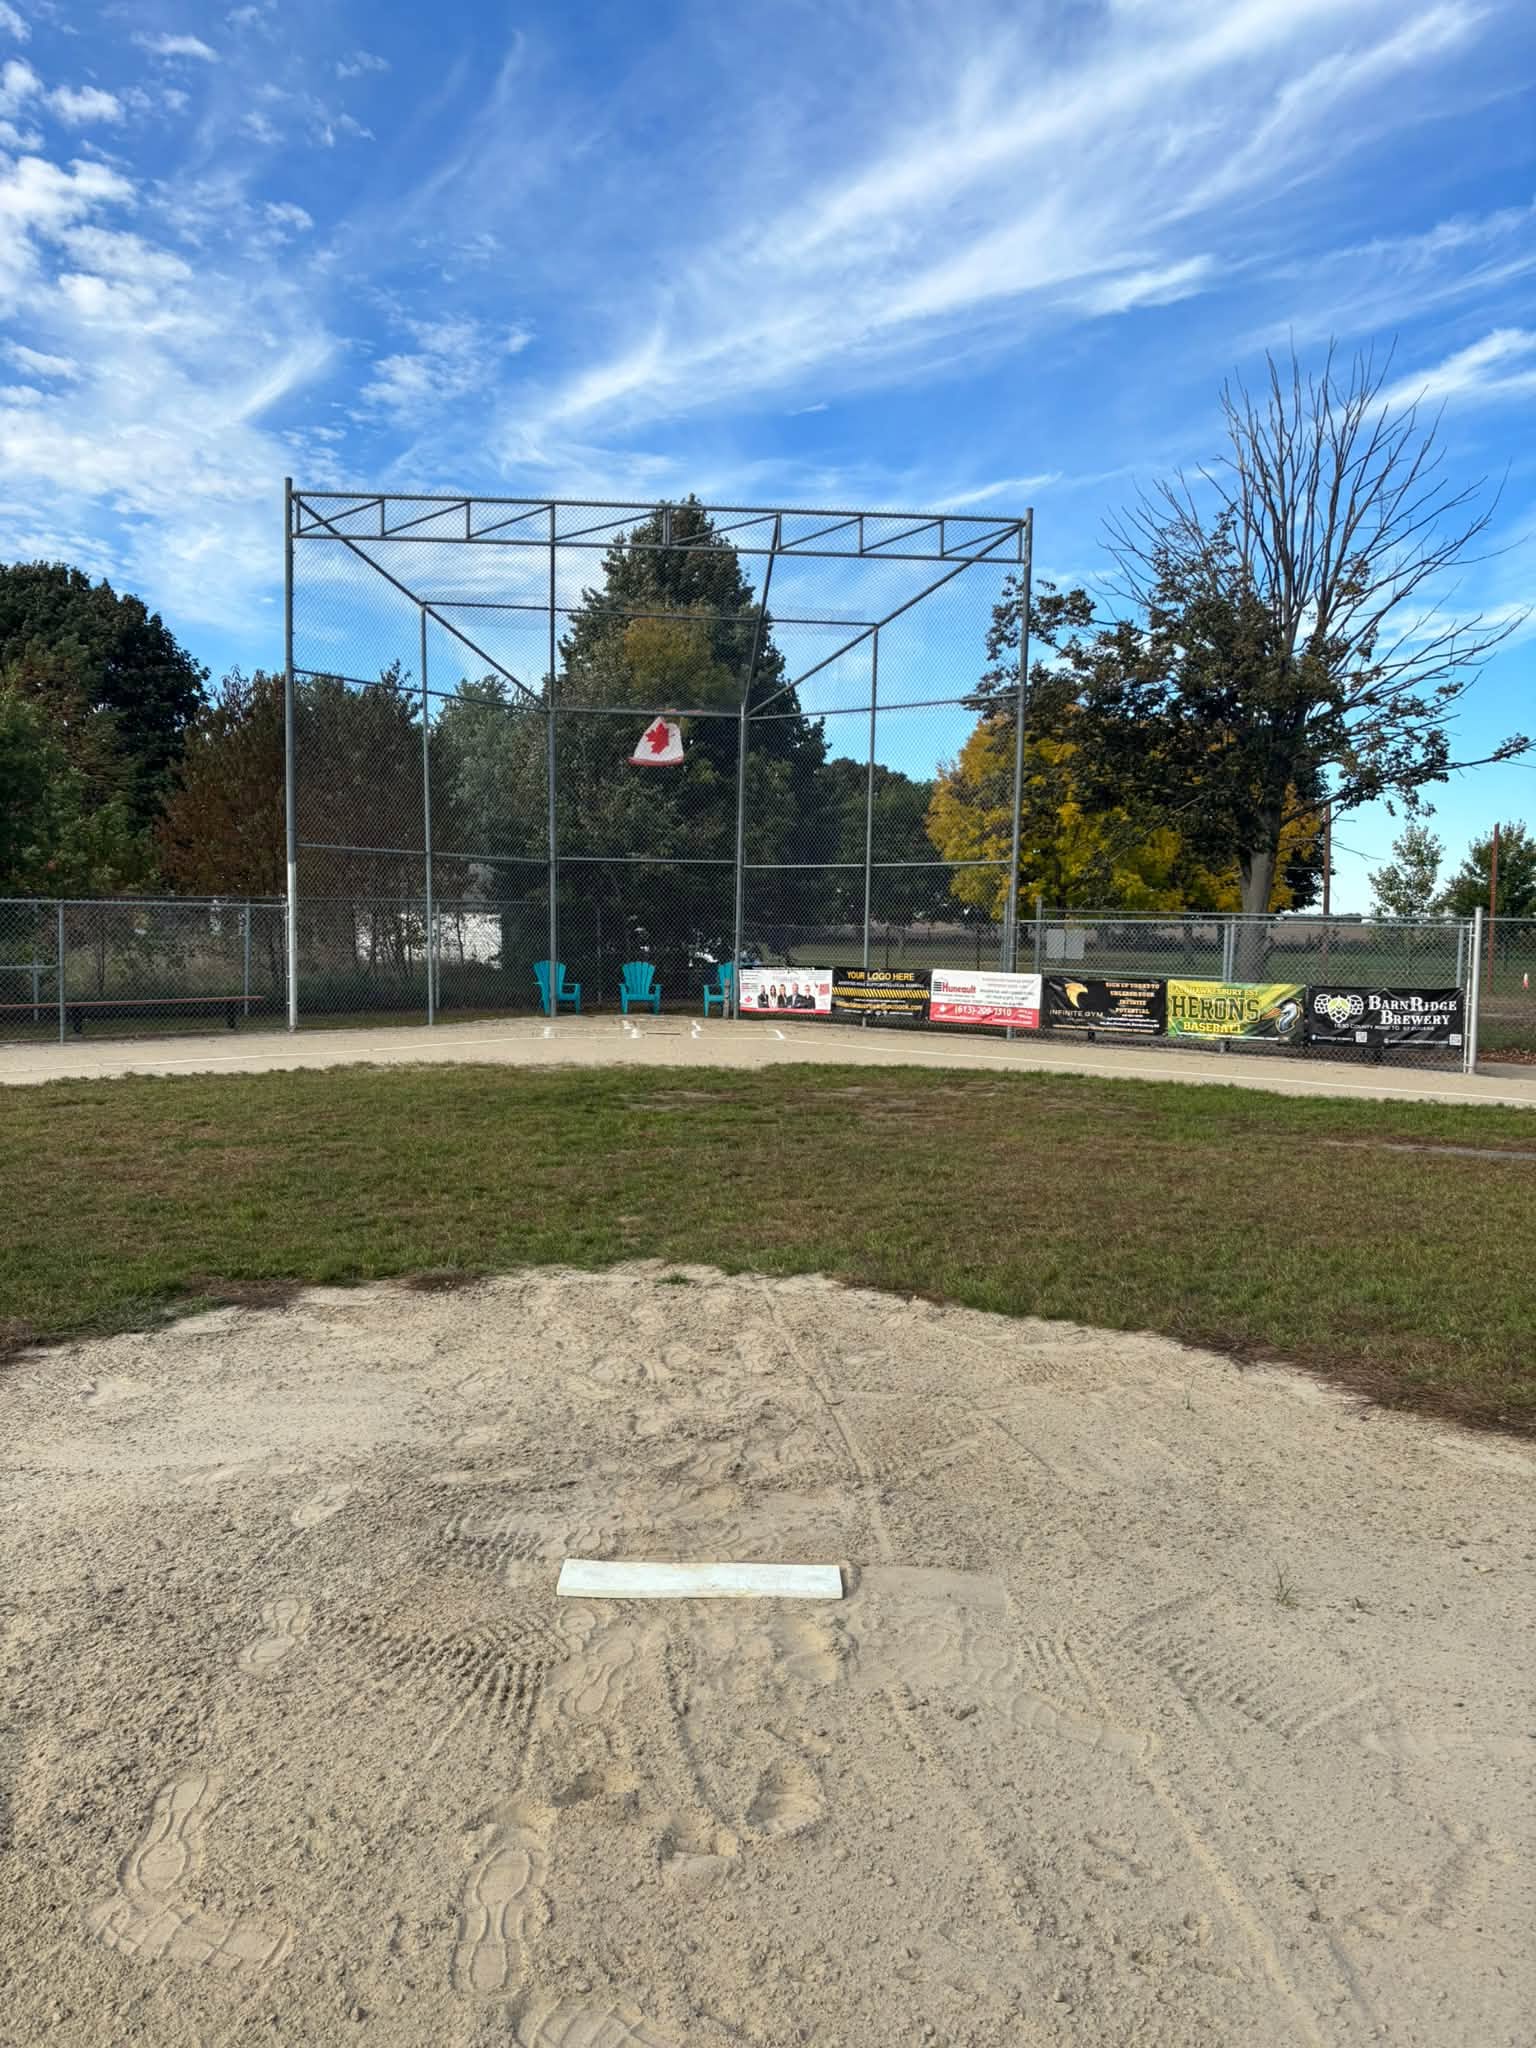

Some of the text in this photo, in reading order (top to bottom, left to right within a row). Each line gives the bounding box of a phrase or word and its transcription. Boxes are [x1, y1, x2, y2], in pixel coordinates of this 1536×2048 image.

[847, 971, 914, 981] YOUR LOGO HERE
[942, 982, 977, 994] Huneault
[1049, 1009, 1083, 1017] INFINITE
[1115, 1007, 1150, 1015] POTENTIAL
[1171, 995, 1260, 1022] HERONS
[1183, 1021, 1243, 1033] BASEBALL
